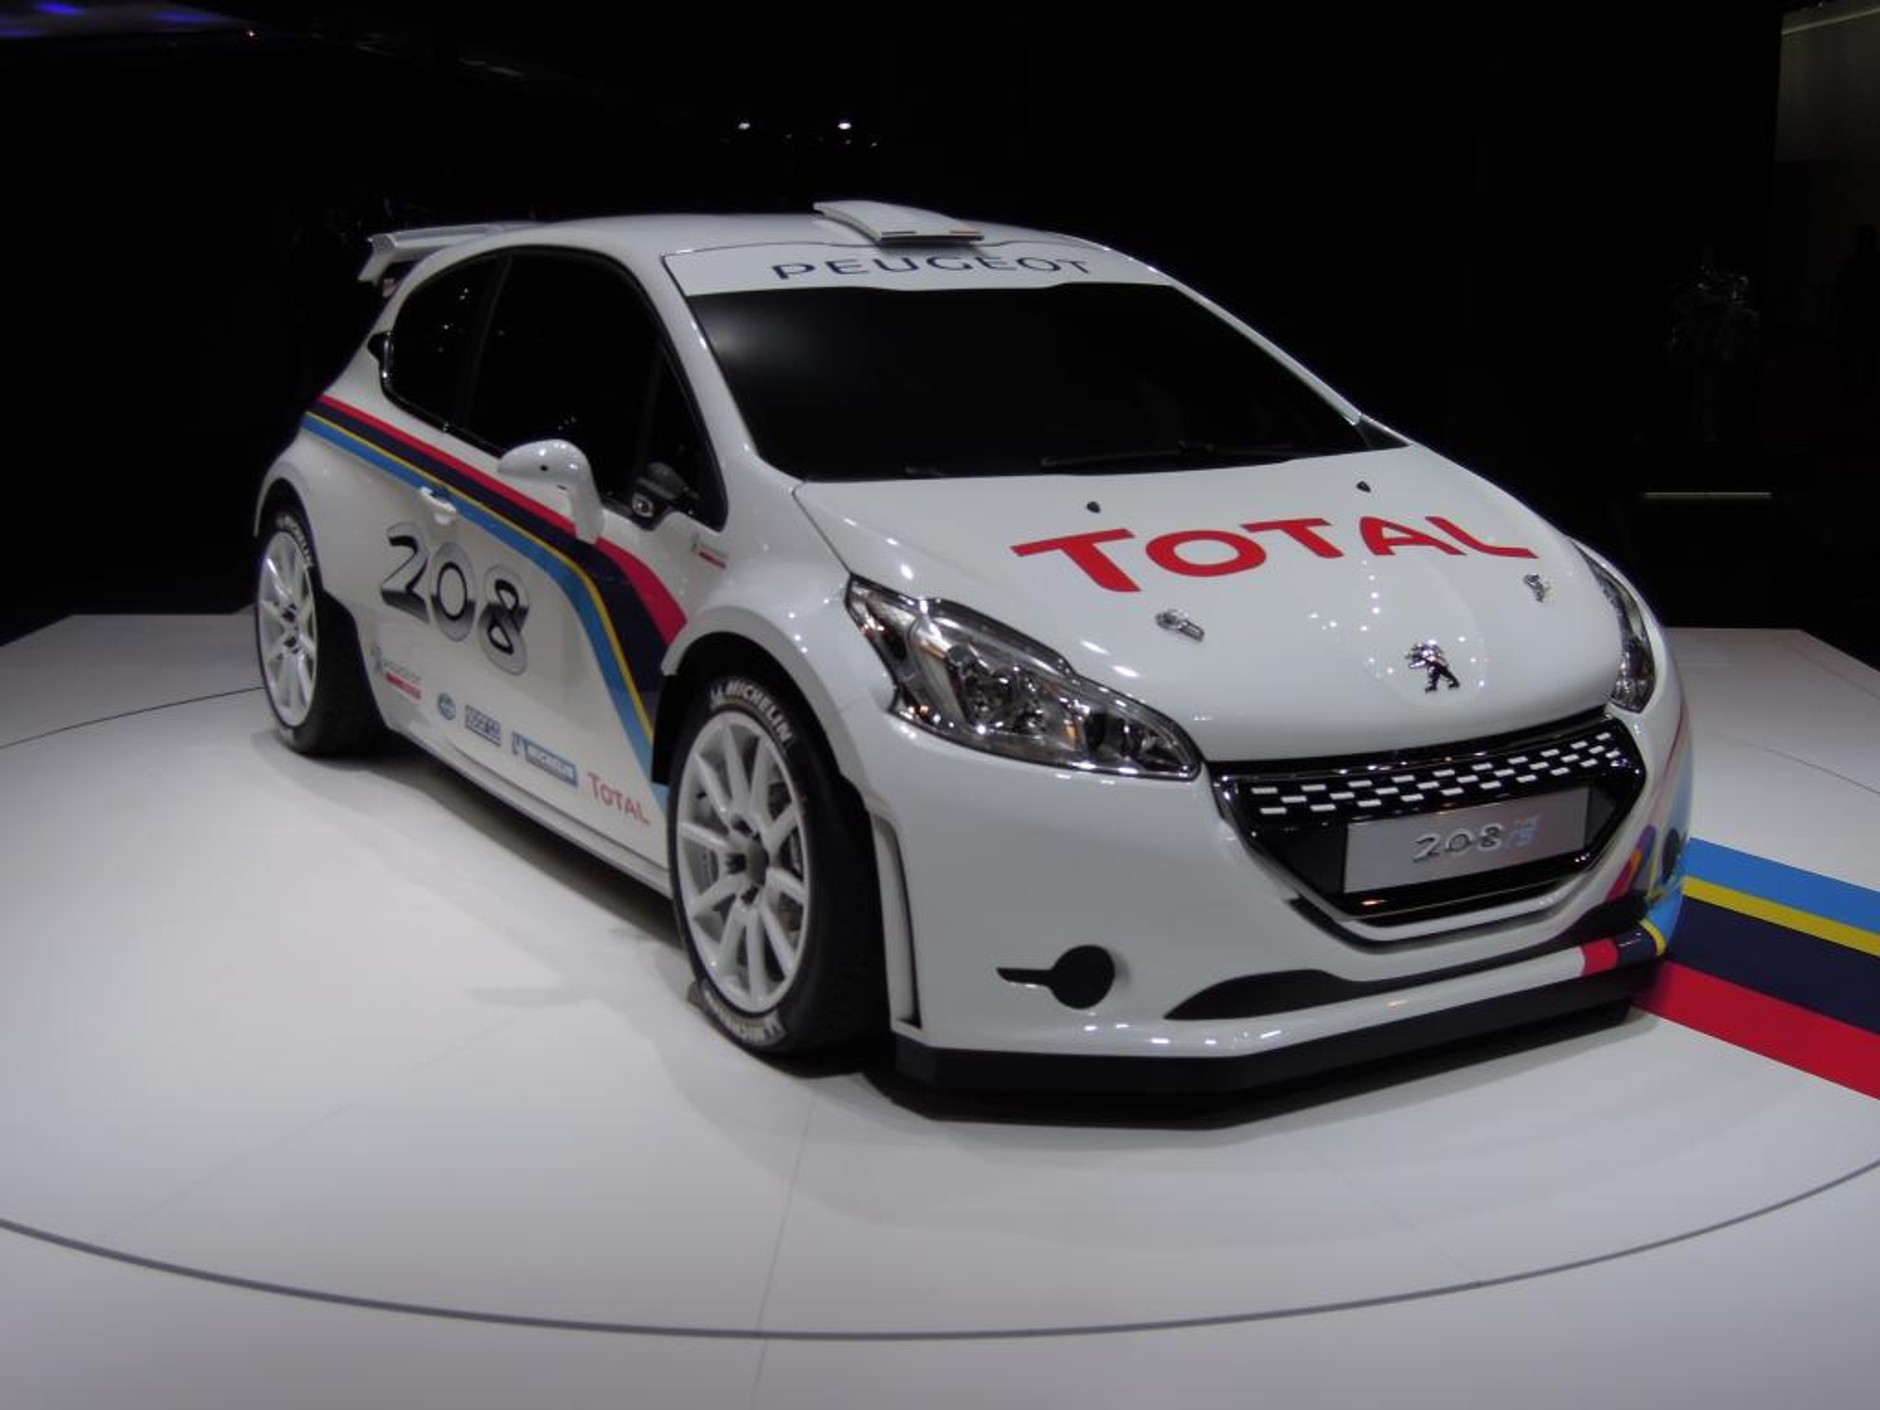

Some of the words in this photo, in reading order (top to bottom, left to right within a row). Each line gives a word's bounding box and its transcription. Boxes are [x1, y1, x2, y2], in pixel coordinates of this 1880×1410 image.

[771, 255, 1092, 280] PEUGEOT
[1010, 515, 1540, 593] TOTAL
[379, 520, 530, 677] 208
[587, 771, 650, 827] TOTAL
[1412, 823, 1505, 864] 208
